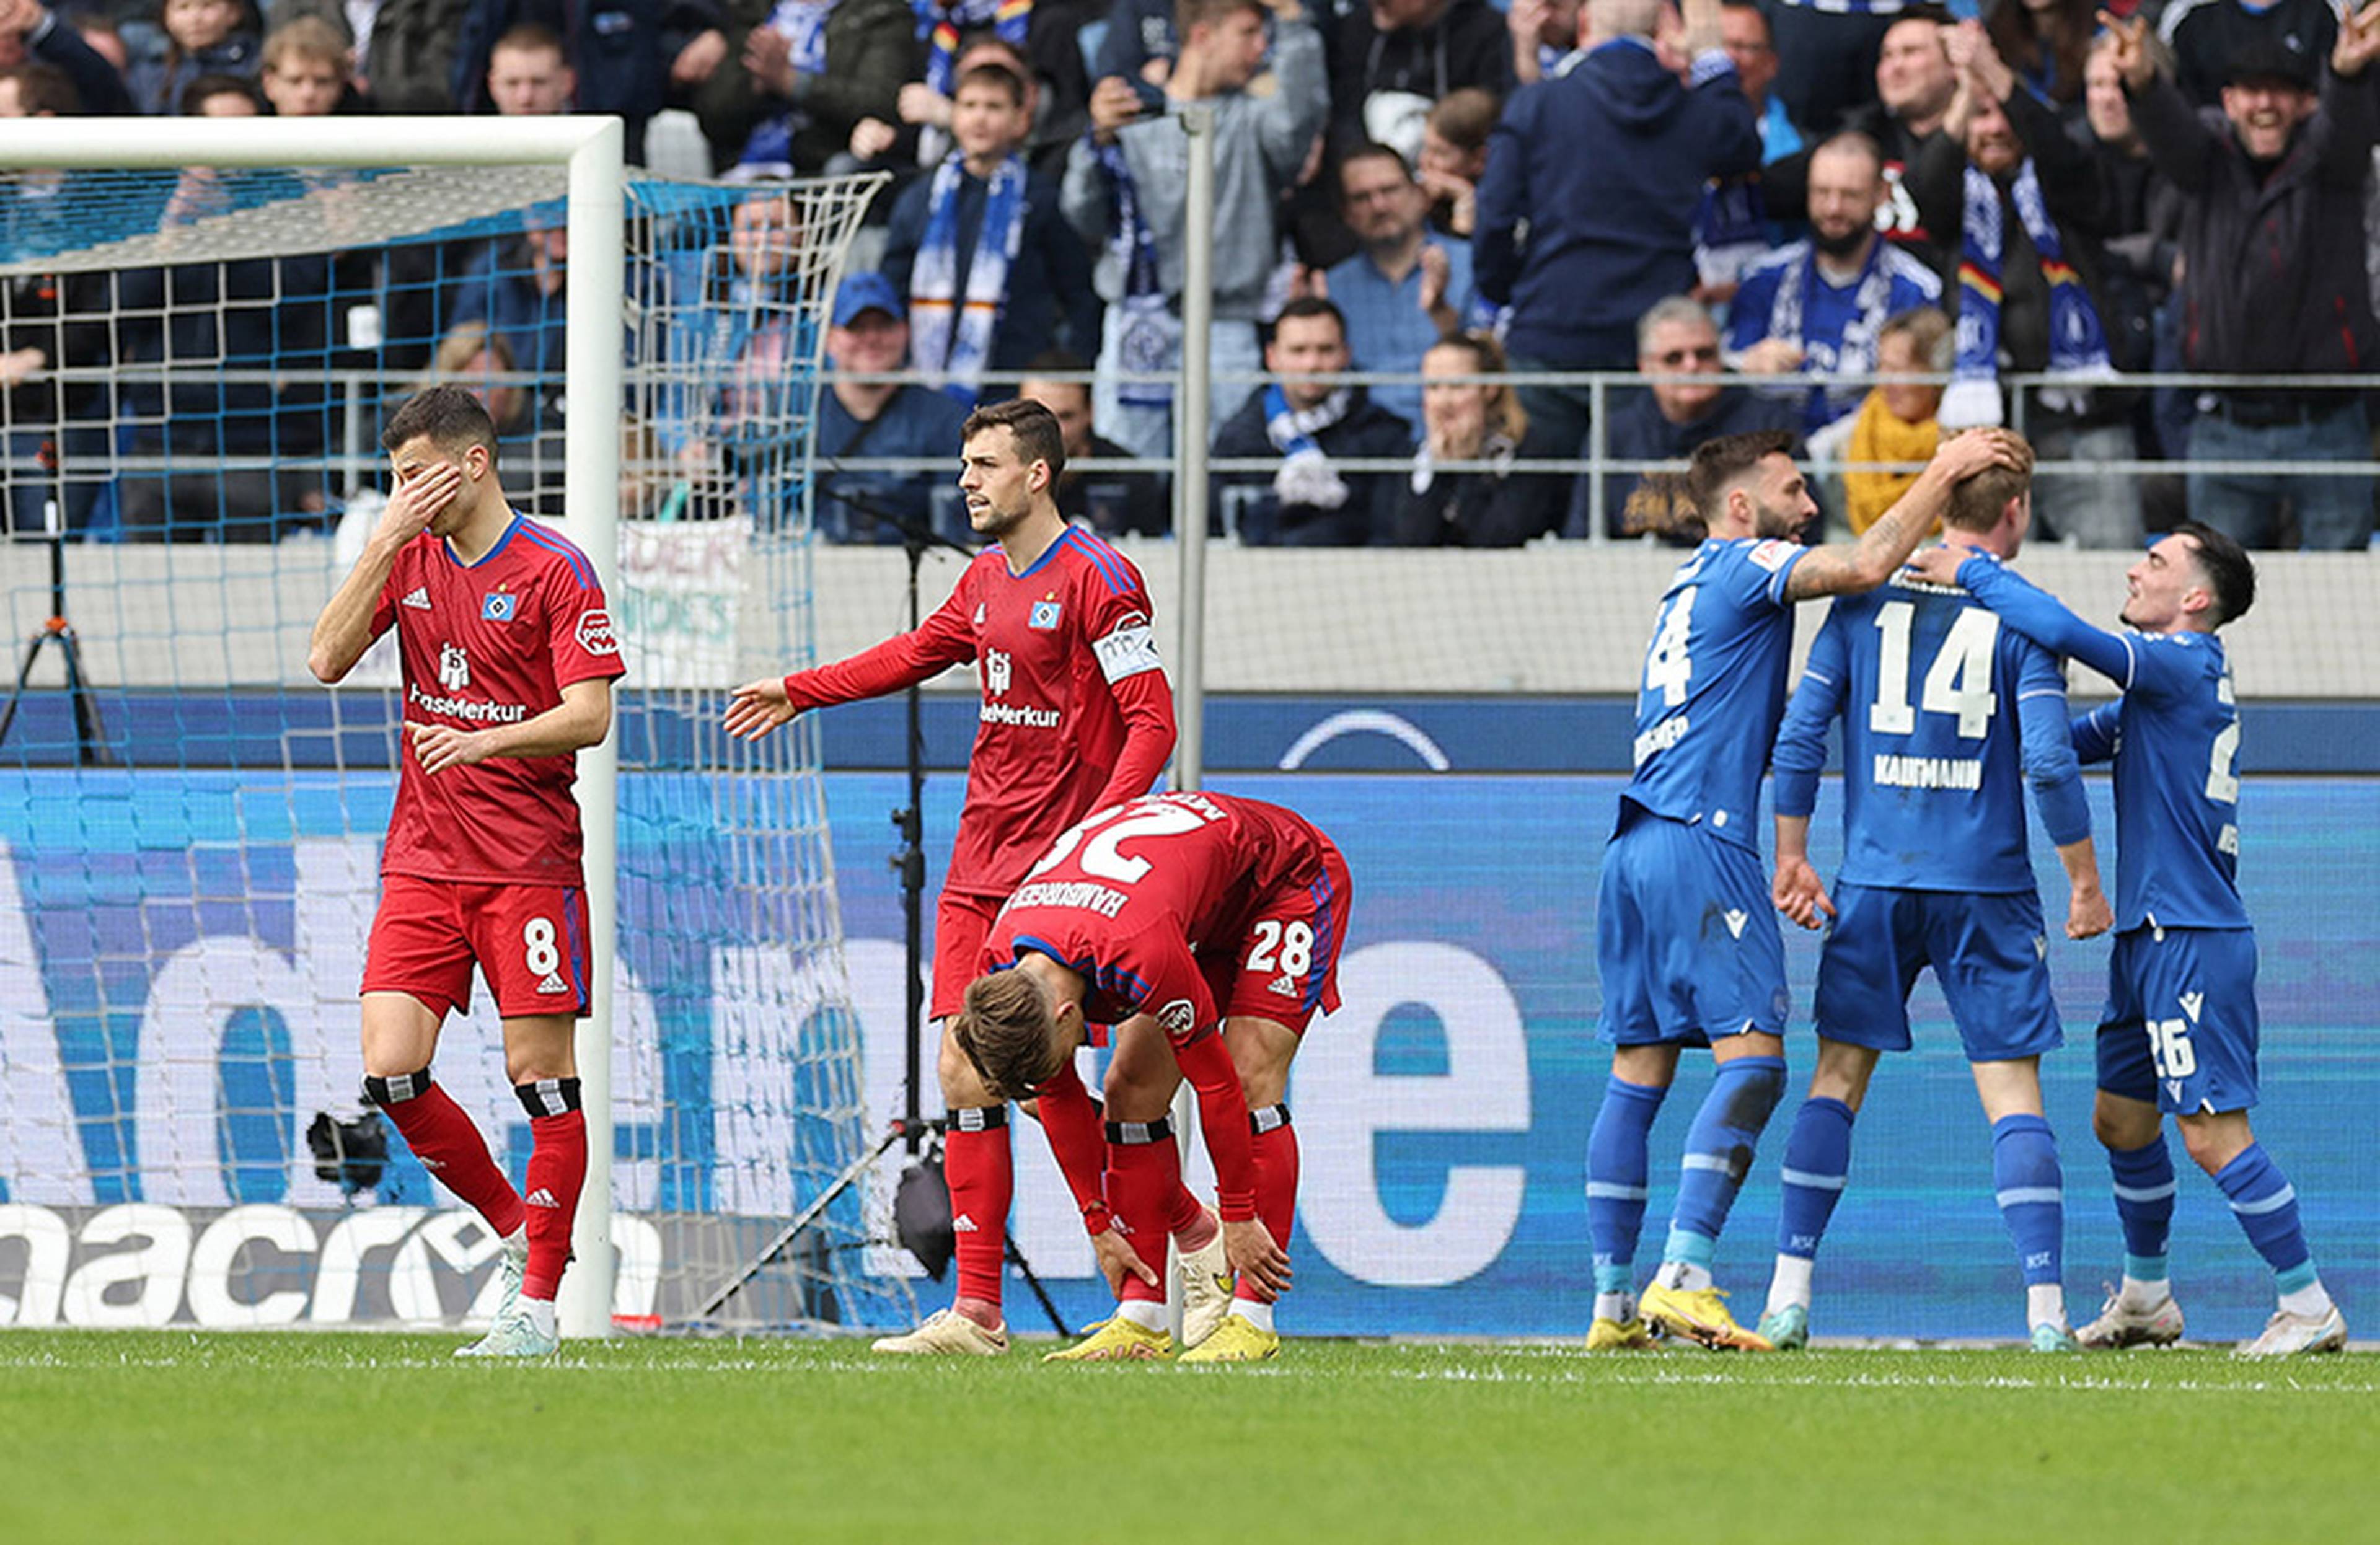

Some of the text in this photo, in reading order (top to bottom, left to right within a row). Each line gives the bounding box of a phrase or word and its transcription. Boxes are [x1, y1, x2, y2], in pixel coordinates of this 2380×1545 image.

[1870, 601, 2000, 739] 14
[1874, 754, 1982, 790] KAUFMANN
[524, 917, 560, 975] 8
[1246, 920, 1315, 977] 28
[2146, 1019, 2197, 1078] 26
